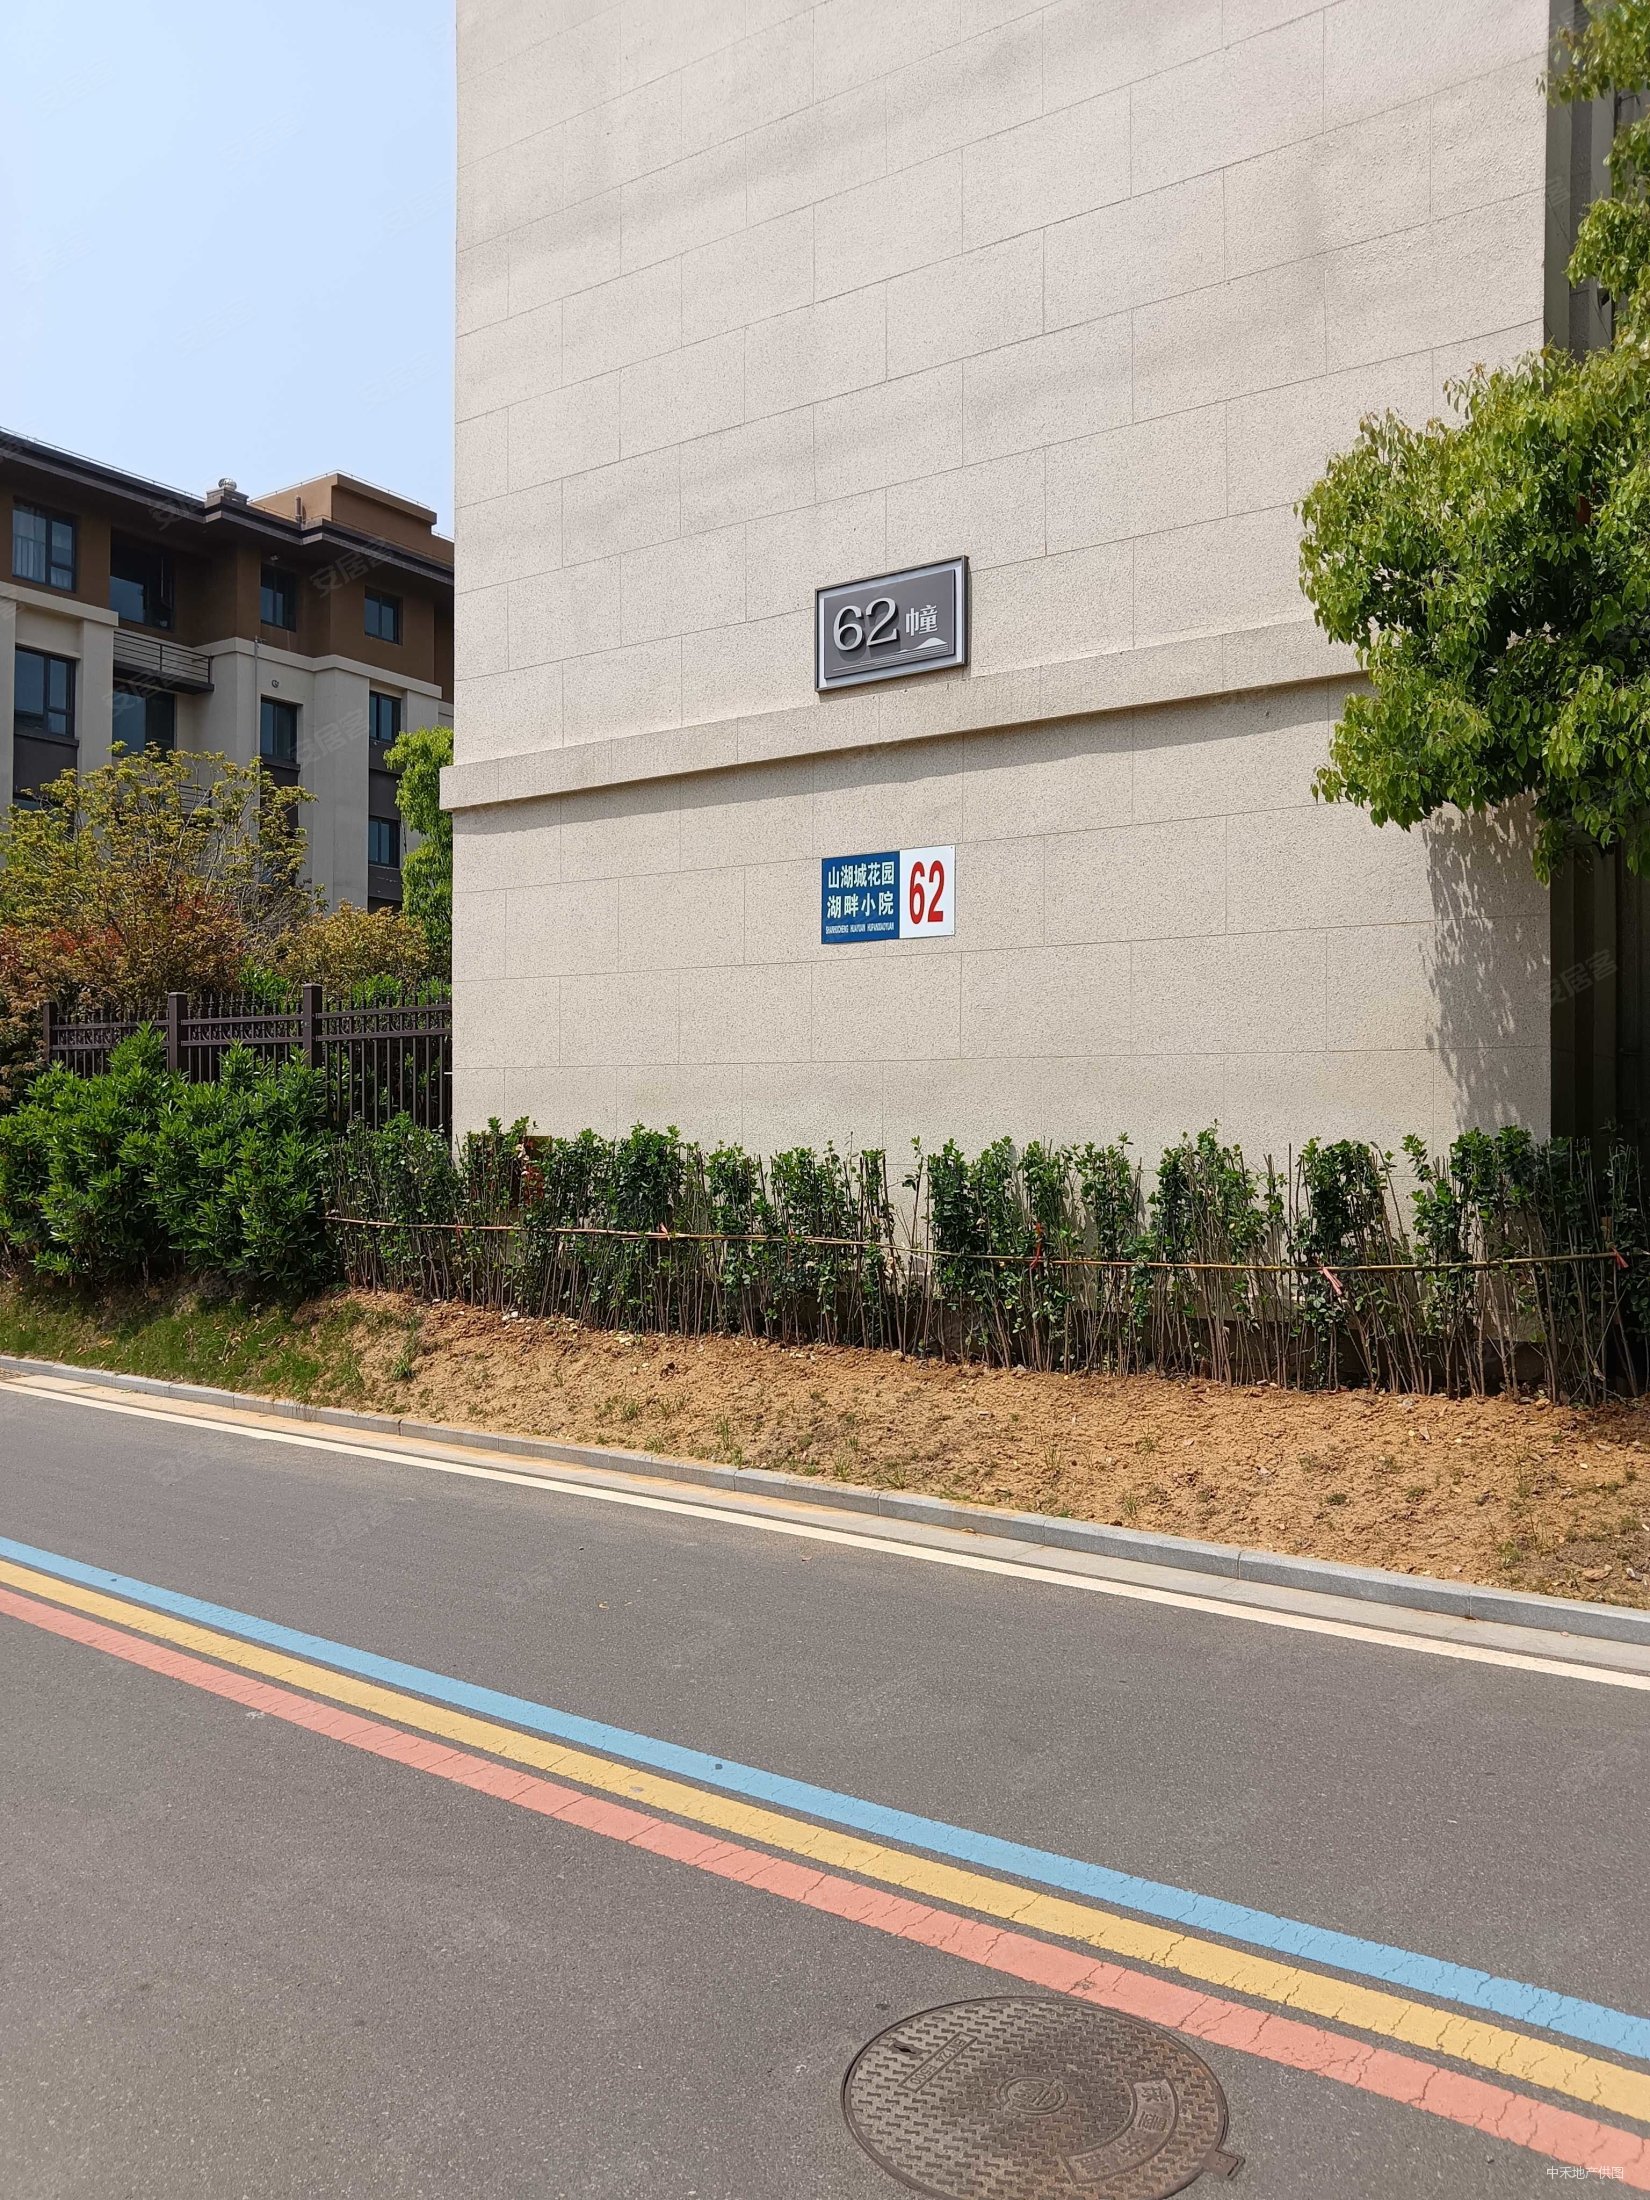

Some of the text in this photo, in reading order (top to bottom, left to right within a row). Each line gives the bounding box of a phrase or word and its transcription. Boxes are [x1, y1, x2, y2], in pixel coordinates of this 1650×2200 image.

[827, 861, 895, 889] 山湖城花园
[826, 890, 894, 919] 湖畔小院
[909, 860, 945, 925] 62
[910, 2063, 938, 2085] E500
